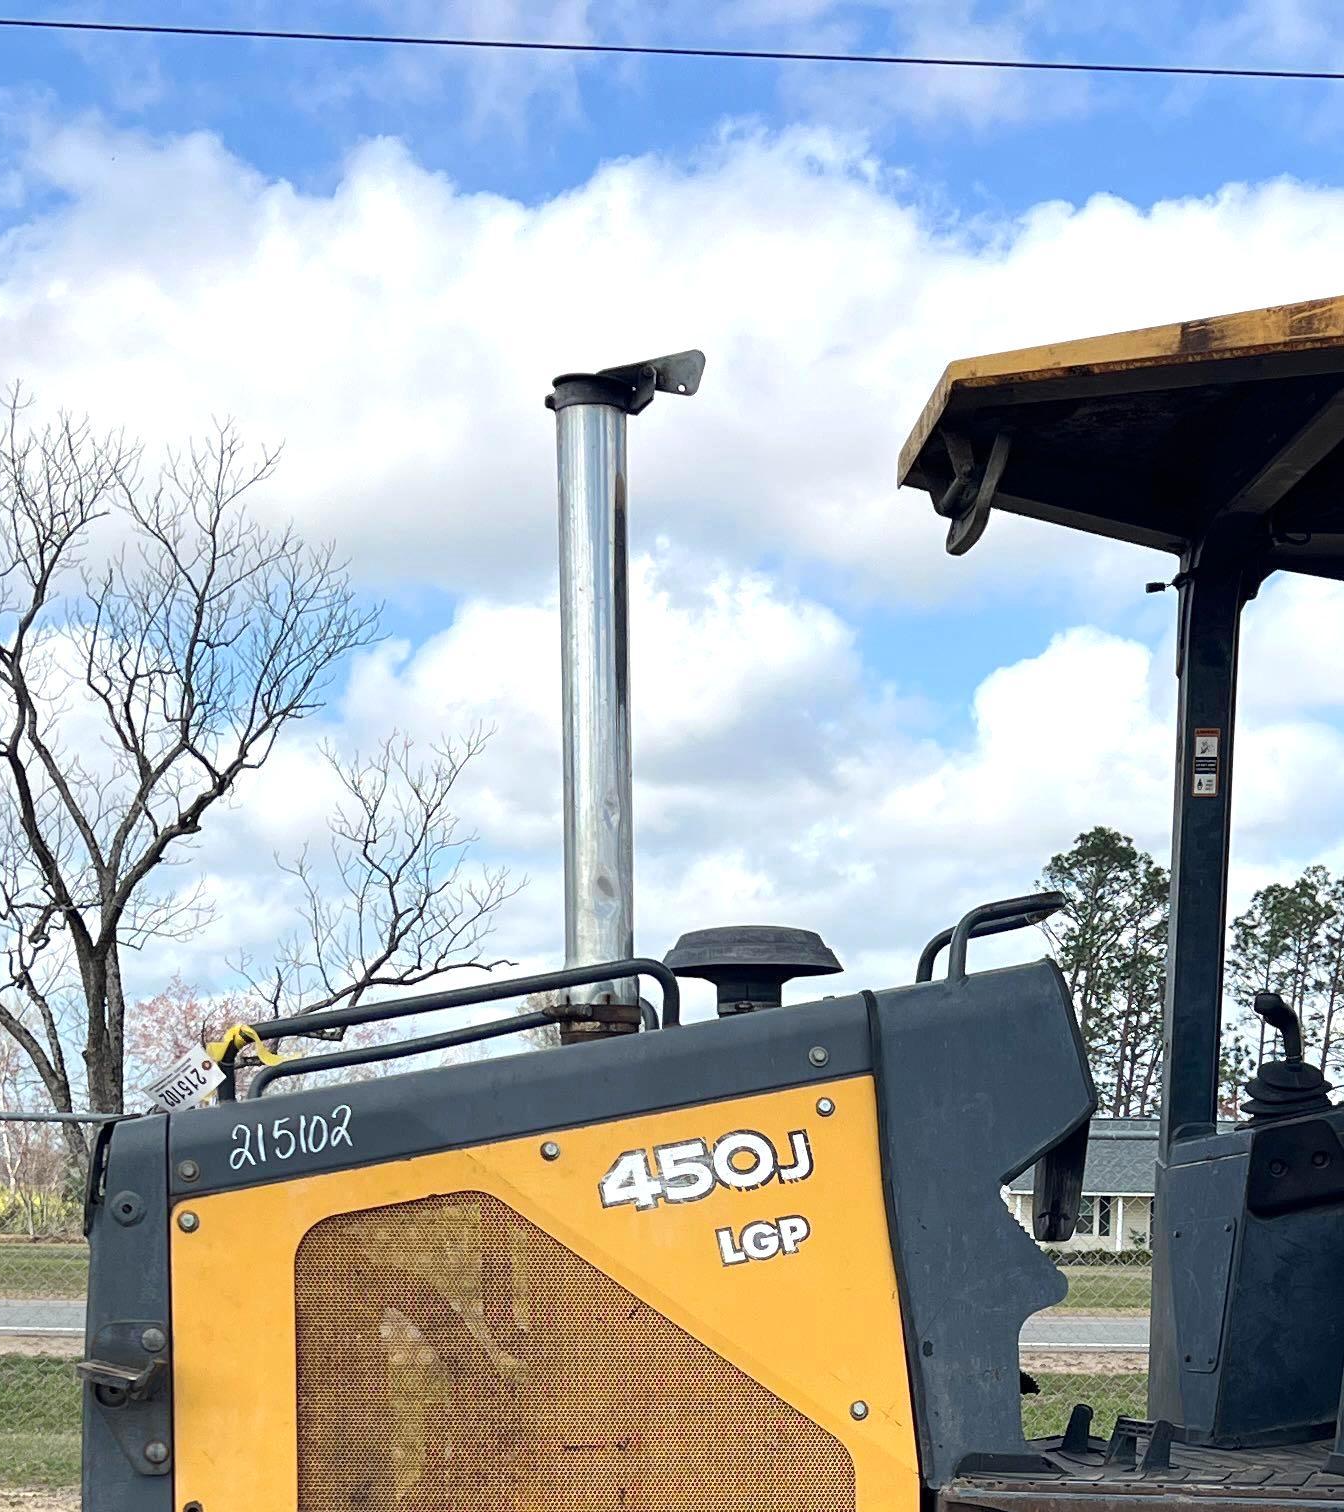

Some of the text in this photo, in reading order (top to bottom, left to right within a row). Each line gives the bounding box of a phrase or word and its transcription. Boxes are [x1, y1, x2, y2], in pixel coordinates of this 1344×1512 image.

[158, 1067, 207, 1107] 215102
[229, 1104, 353, 1170] 215102
[598, 1129, 814, 1212] 450J
[715, 1215, 811, 1267] LGP
